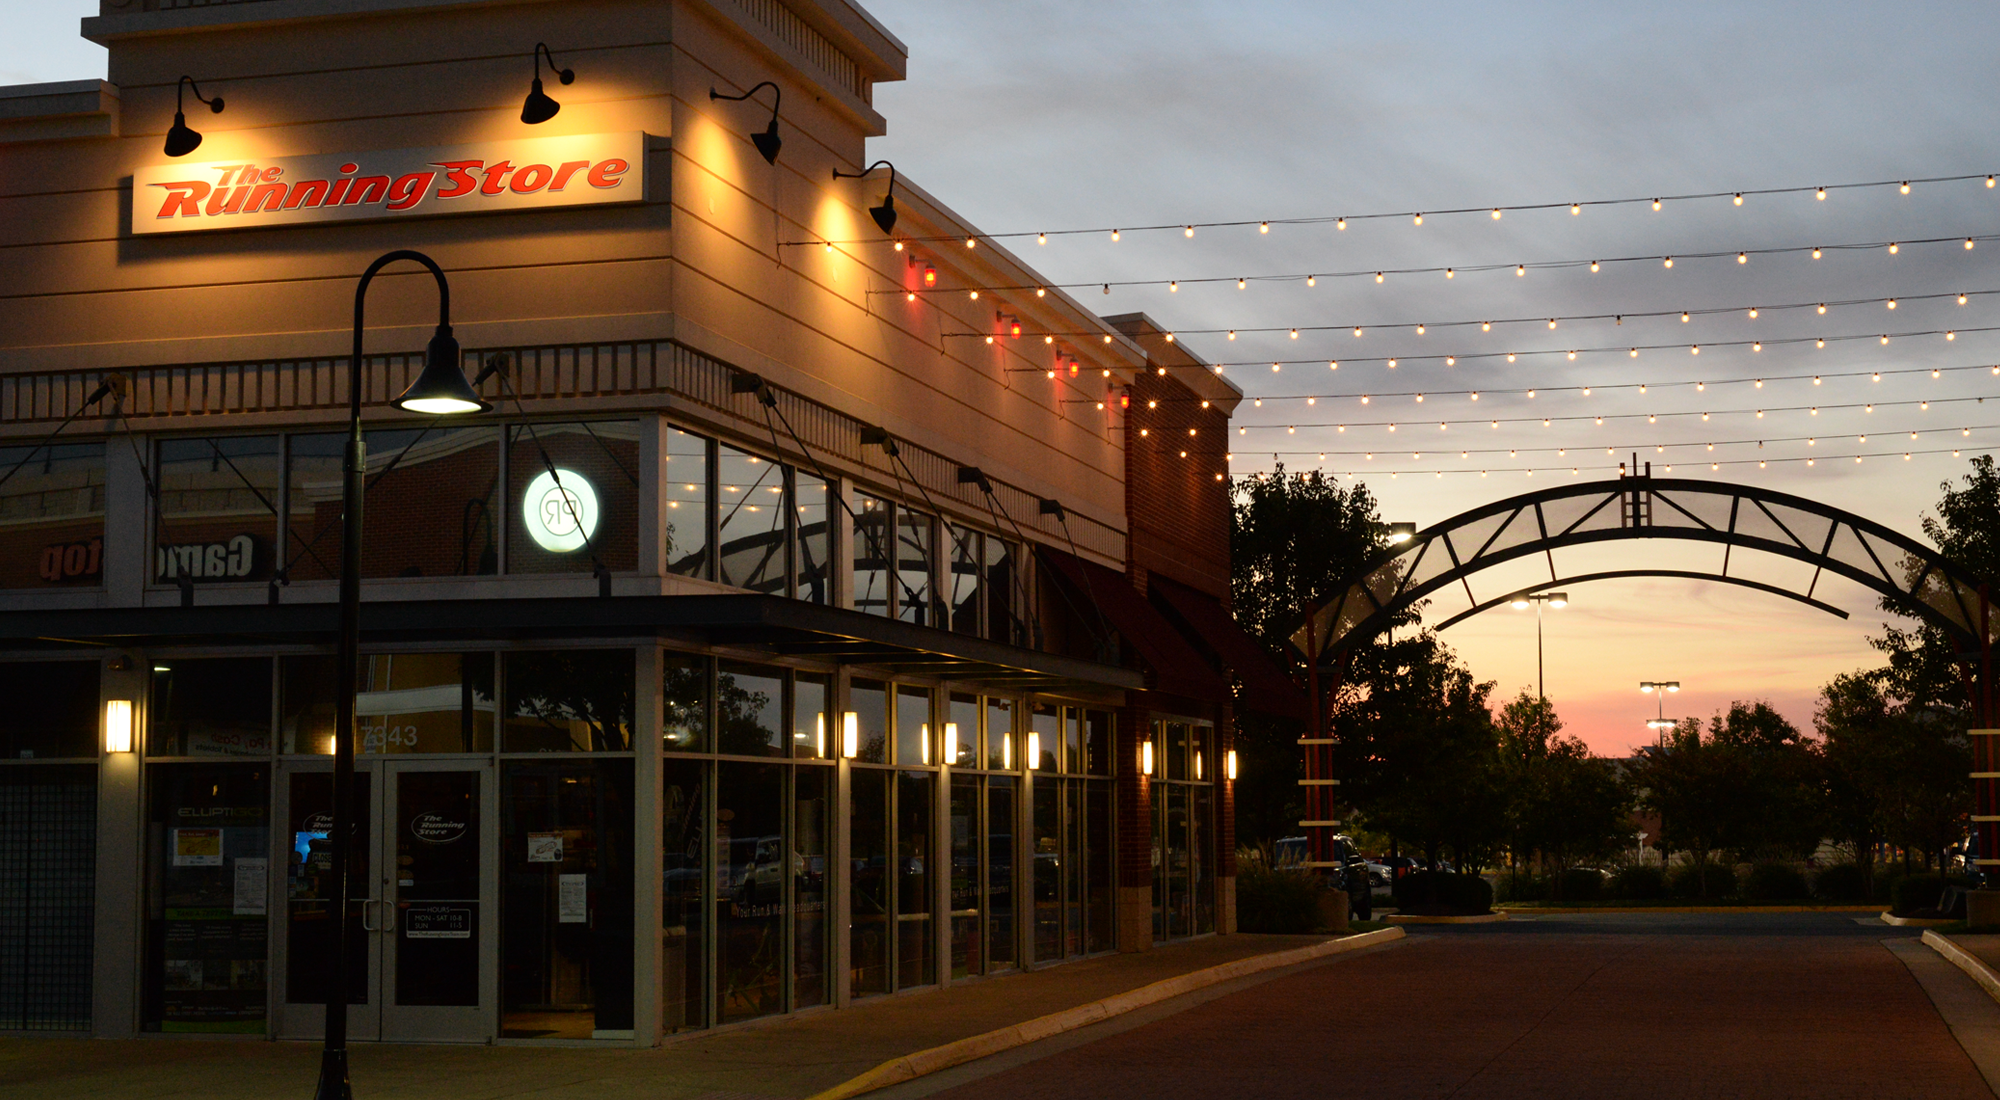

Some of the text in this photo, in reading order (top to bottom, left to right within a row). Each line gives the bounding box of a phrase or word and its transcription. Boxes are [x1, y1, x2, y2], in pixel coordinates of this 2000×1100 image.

[211, 163, 285, 188] The
[146, 157, 629, 220] Running Store
[360, 725, 418, 746] 7343
[177, 806, 264, 818] ELLIPTIGO
[423, 814, 443, 822] The
[420, 820, 465, 830] Running
[417, 828, 448, 836] Store
[313, 853, 332, 863] CLOSE
[426, 906, 450, 914] HOURS
[414, 914, 432, 922] MON
[436, 914, 449, 922] SAT
[449, 914, 463, 922] 10-8
[414, 922, 429, 930] SUN
